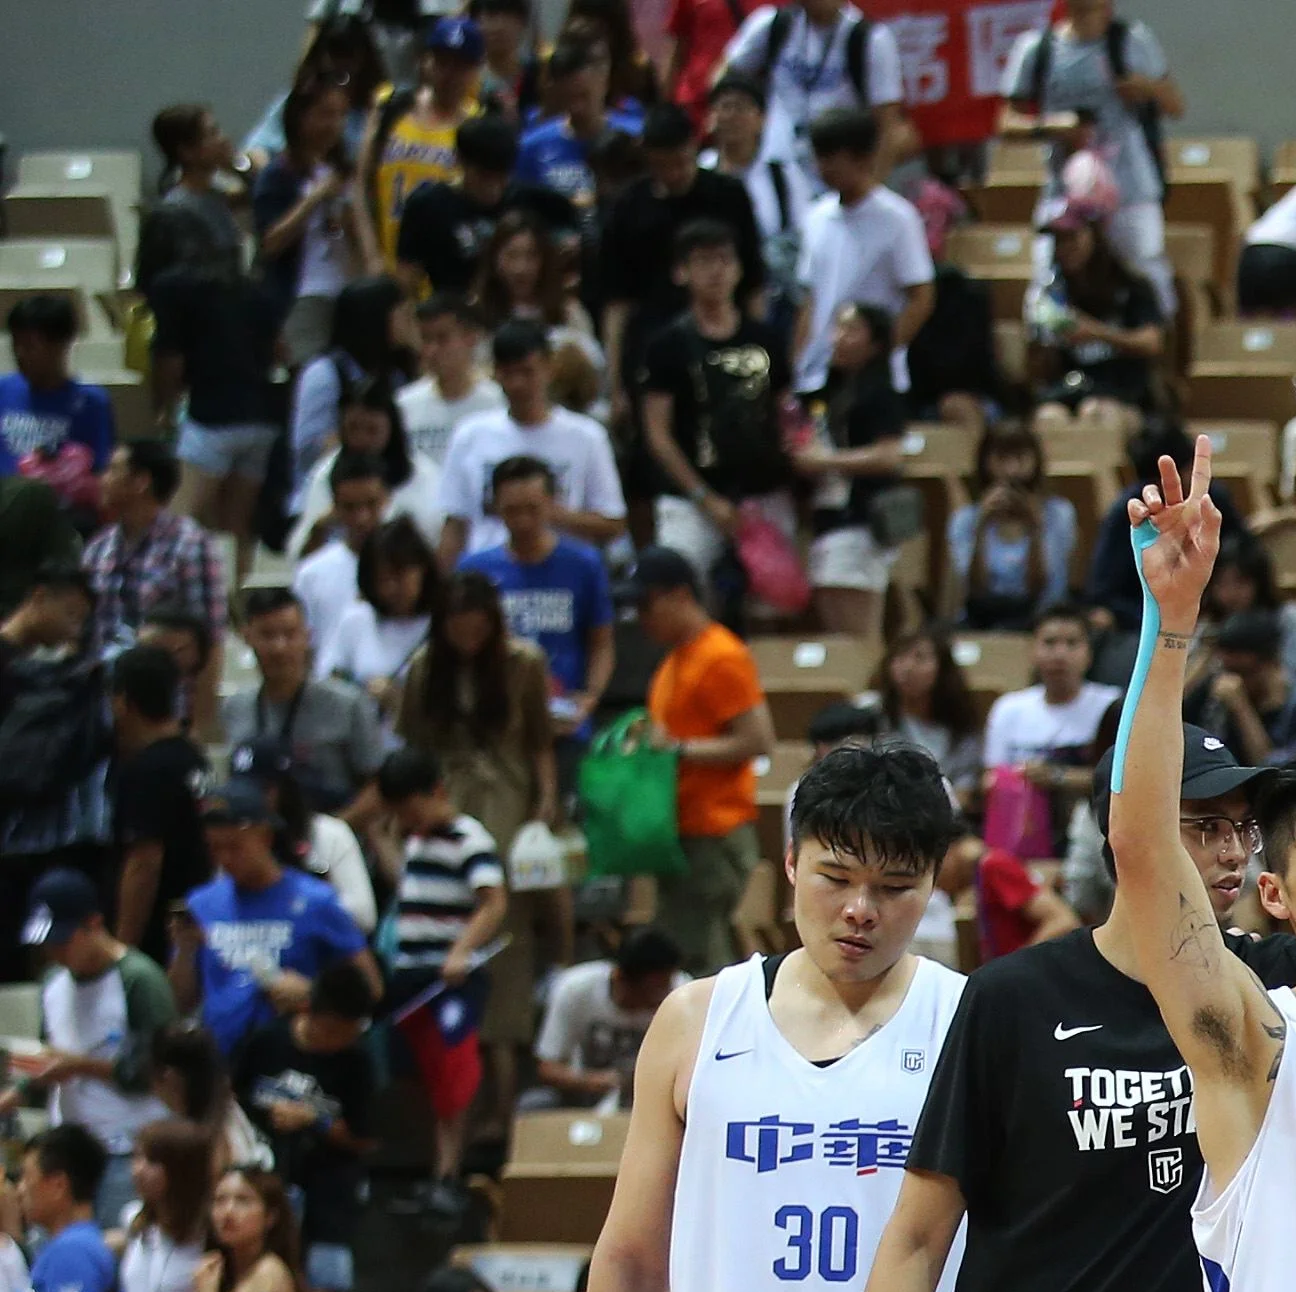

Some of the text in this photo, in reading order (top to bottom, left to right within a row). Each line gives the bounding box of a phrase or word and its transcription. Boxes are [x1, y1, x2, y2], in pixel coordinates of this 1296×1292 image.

[1064, 1064, 1194, 1108] TOGET
[726, 1114, 912, 1177] 中華
[1067, 1108, 1137, 1151] WE
[773, 1204, 858, 1282] 30
